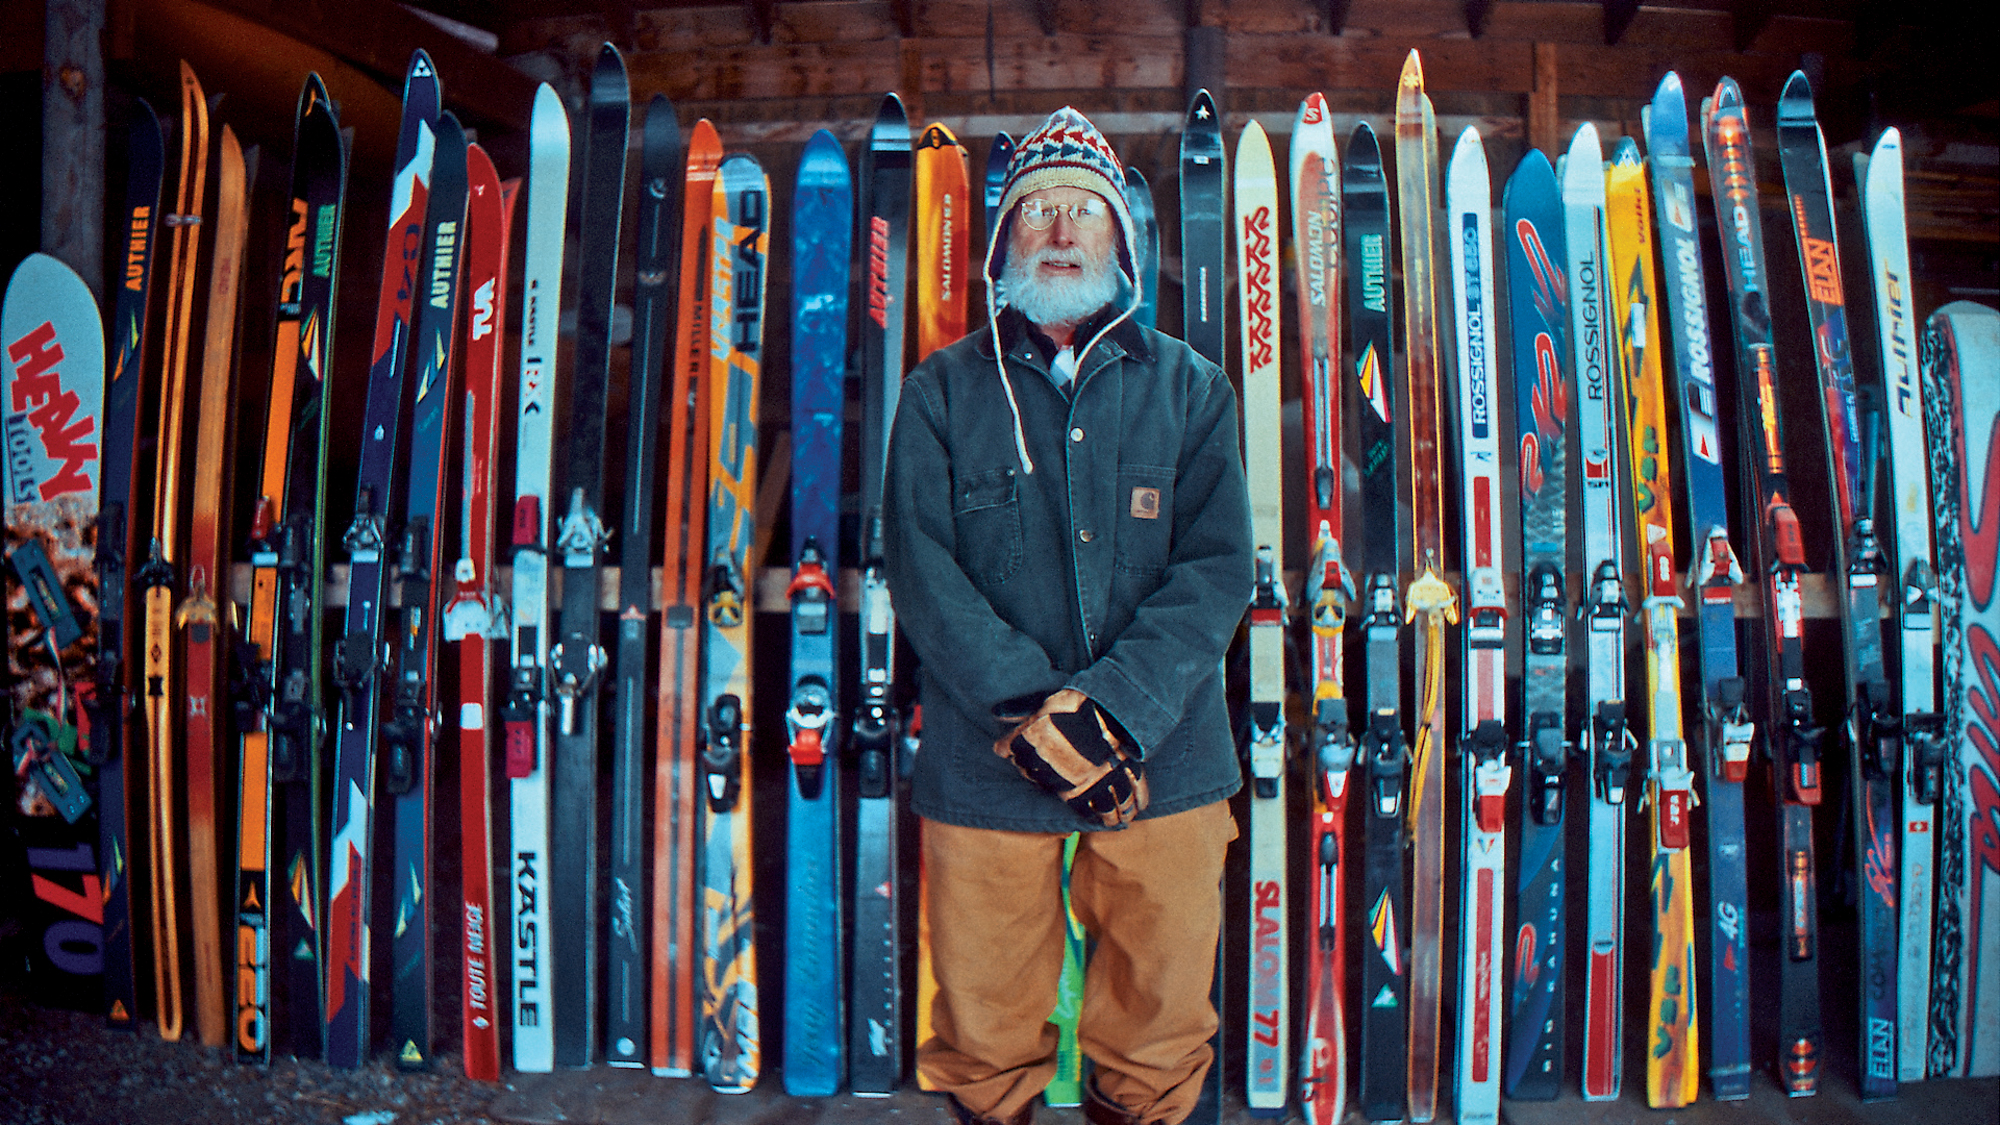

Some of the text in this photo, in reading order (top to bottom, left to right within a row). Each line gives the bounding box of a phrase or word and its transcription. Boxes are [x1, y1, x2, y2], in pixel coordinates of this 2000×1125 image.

[125, 205, 150, 291] AUTHIER
[313, 203, 337, 278] AUTHIER
[430, 221, 457, 309] AUTHIER
[736, 190, 765, 353] HEAD
[869, 215, 891, 330] AUTHIER
[941, 219, 953, 302] SALOMON
[1309, 209, 1326, 307] SALOMON
[1361, 234, 1385, 312] AUTHIER
[1733, 205, 1758, 292] HEAD
[1807, 239, 1838, 301] ELAN
[1580, 250, 1604, 402] ROSSIGNOL
[1677, 238, 1713, 384] ROSSIGNOL
[1468, 303, 1486, 425] ROSSIGNOL
[8, 320, 98, 502] HEAVY
[27, 842, 104, 976] 170
[465, 900, 487, 1011] TOUTE NEIGE
[1254, 881, 1281, 1007] SLALOM
[1717, 900, 1740, 941] 4G
[1254, 1009, 1279, 1048] 77
[1872, 1018, 1891, 1079] ELAN
